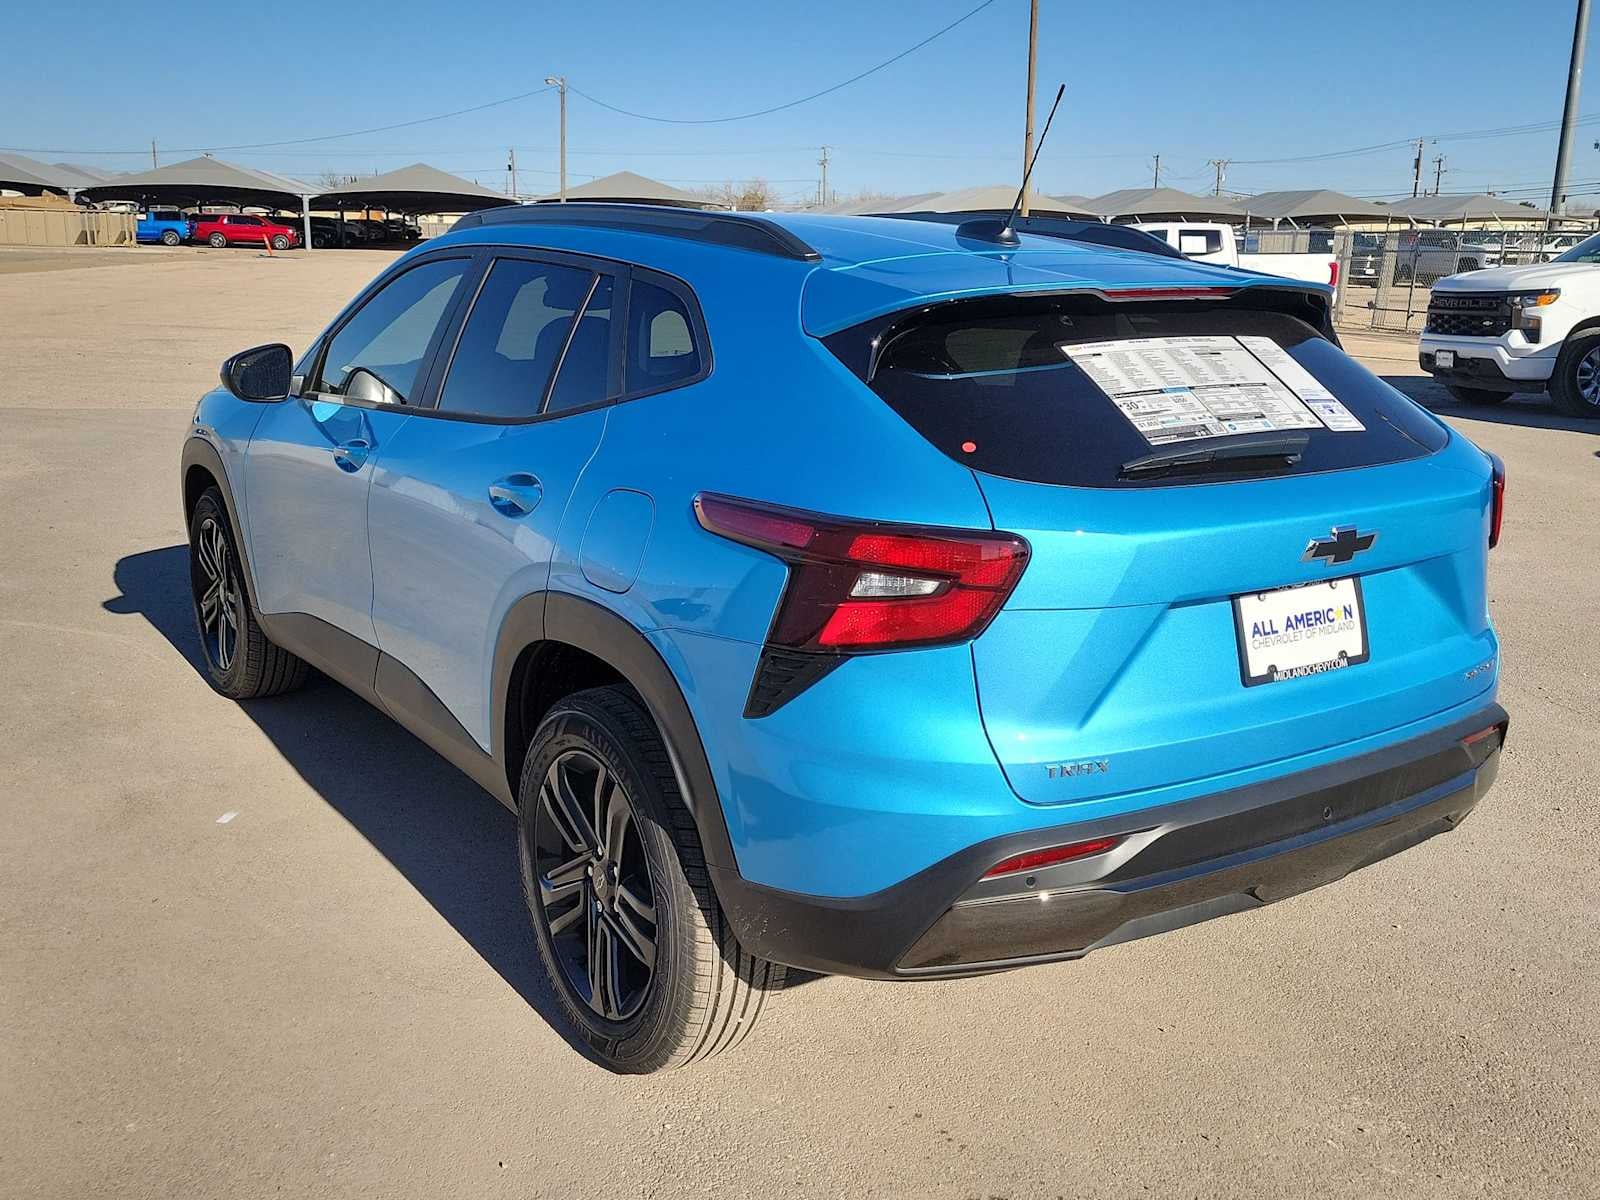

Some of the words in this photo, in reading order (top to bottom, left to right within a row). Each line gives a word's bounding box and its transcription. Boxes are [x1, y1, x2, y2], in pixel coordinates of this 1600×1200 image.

[1252, 619, 1279, 639] ALL
[1285, 604, 1352, 632] AMERICN
[1252, 630, 1303, 650] CHEVROLET
[1305, 629, 1317, 640] OF
[1318, 620, 1355, 636] MIDLAND
[1045, 758, 1110, 779] TRAX
